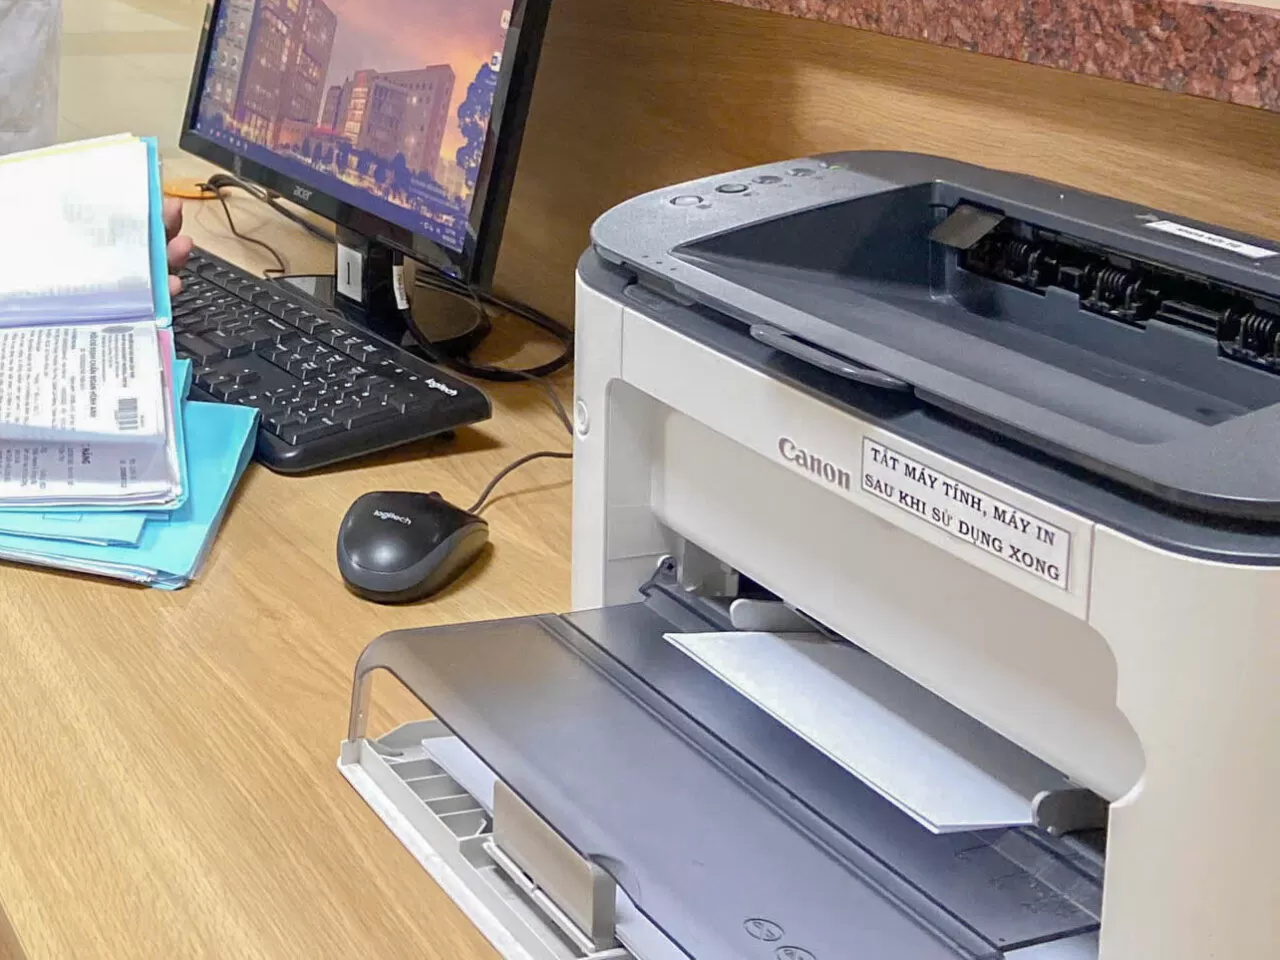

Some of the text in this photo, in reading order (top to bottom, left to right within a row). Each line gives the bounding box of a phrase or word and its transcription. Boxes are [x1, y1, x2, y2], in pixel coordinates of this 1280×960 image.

[778, 436, 851, 491] Canon
[373, 508, 413, 526] logitech
[864, 473, 895, 498] SAU
[898, 489, 927, 516] KHI
[958, 518, 1004, 553] DỤNG
[1008, 545, 1061, 582] XONG
[904, 463, 939, 490] MÁY
[942, 480, 989, 517] TÍNH,
[992, 506, 1032, 535] MÁY
[1035, 526, 1056, 546] IN
